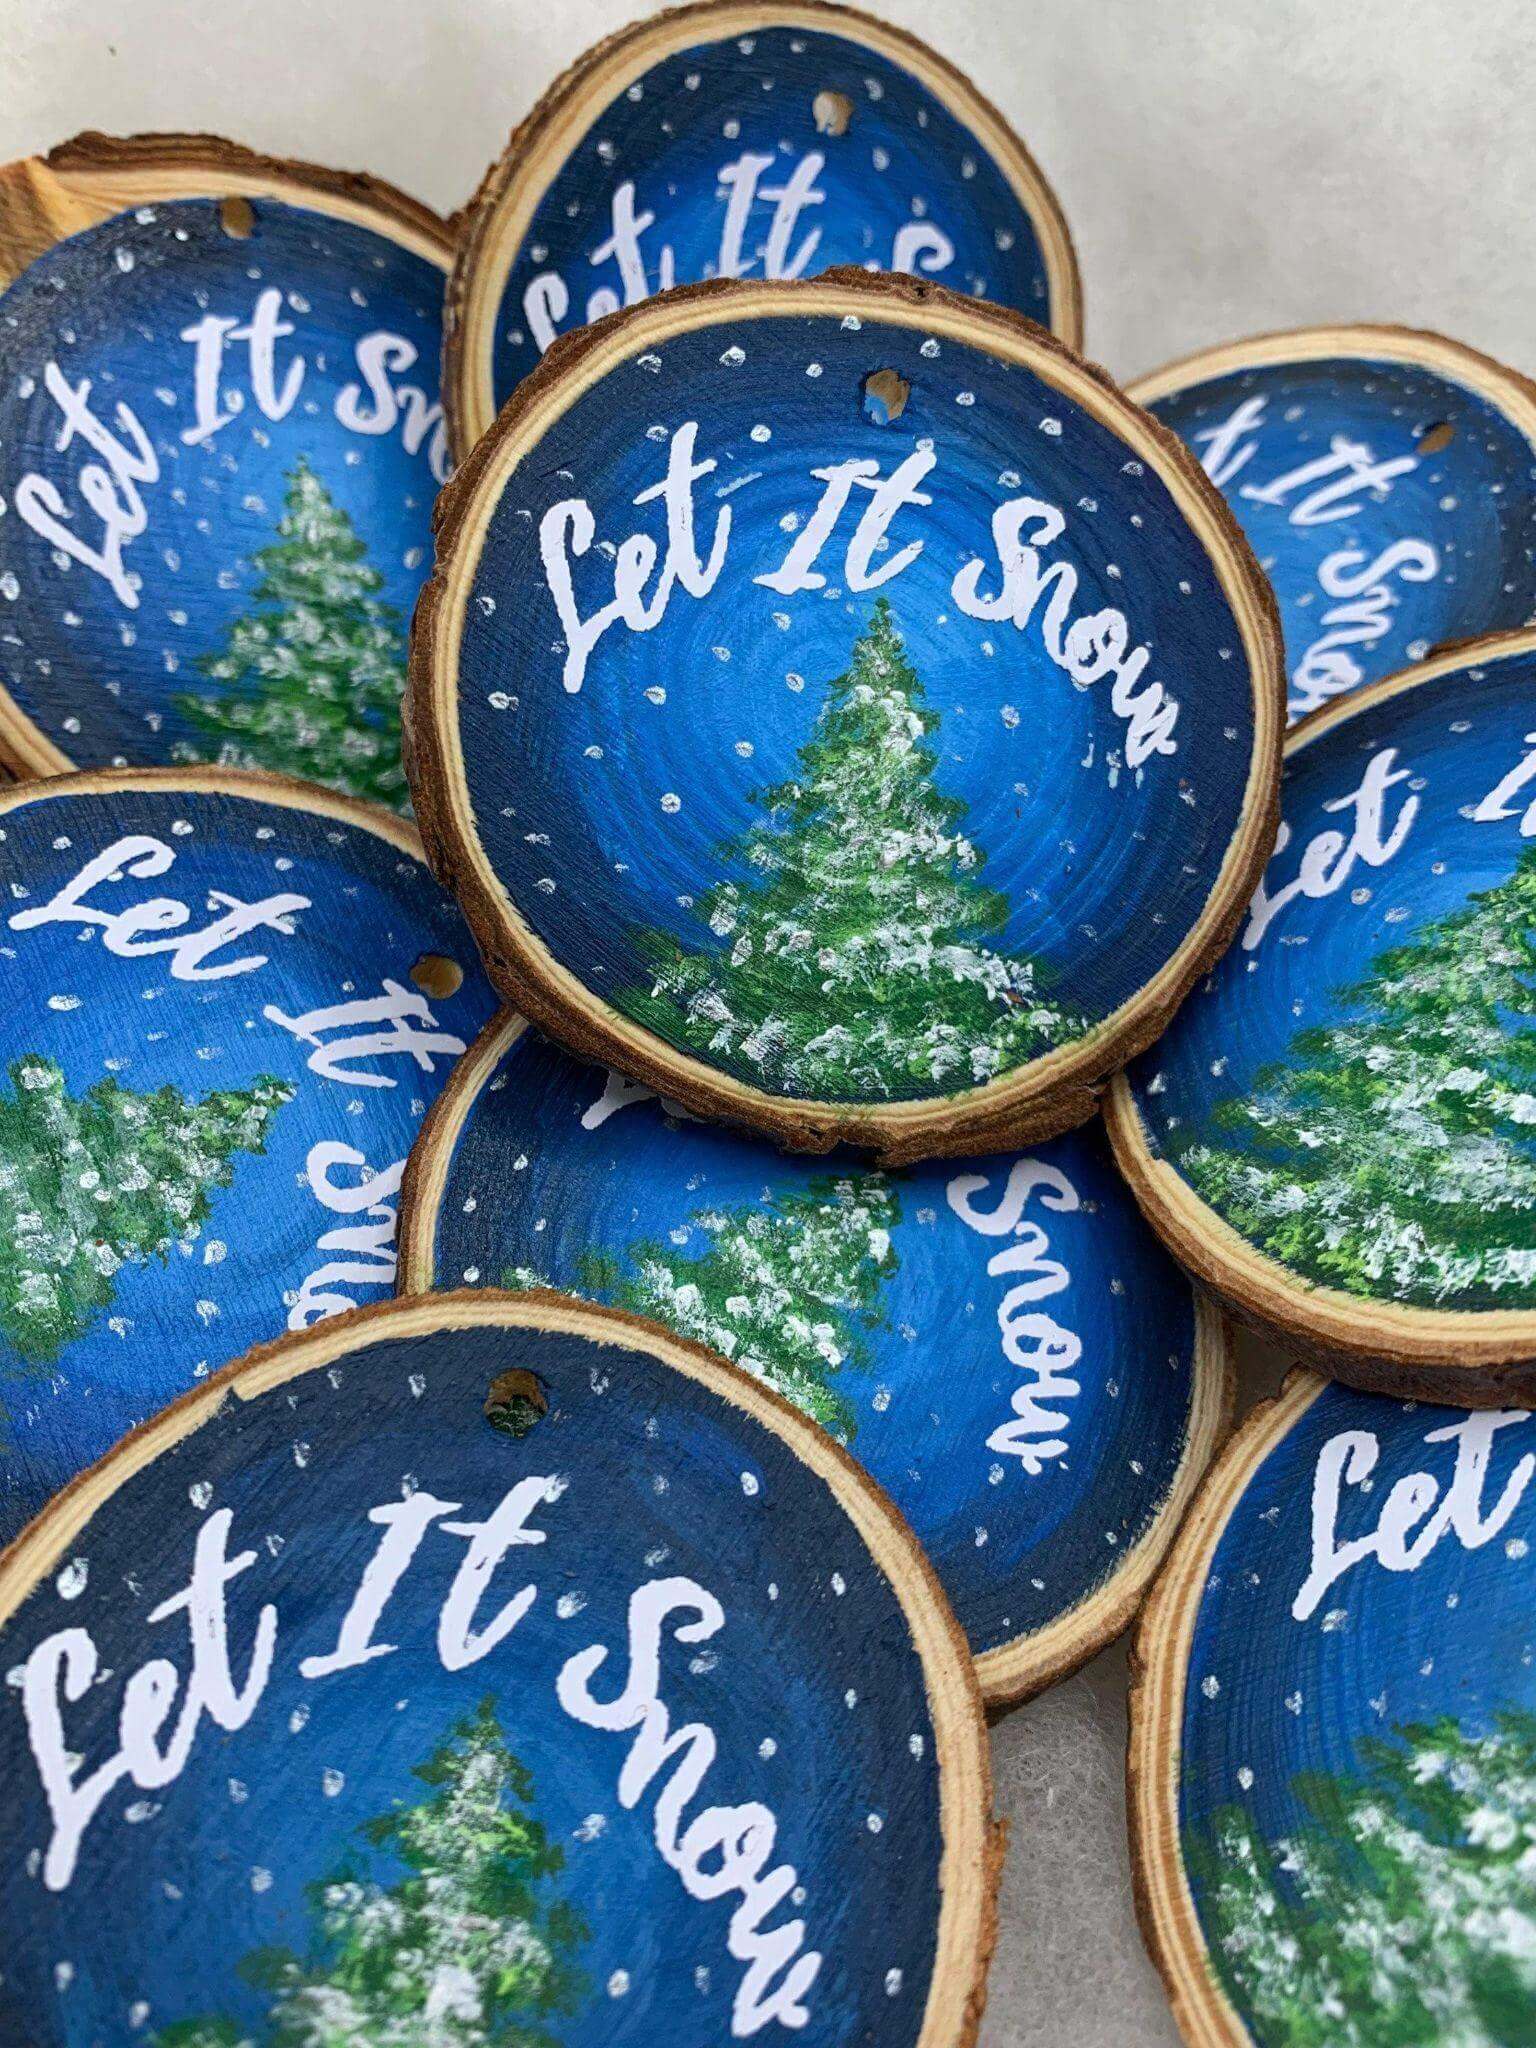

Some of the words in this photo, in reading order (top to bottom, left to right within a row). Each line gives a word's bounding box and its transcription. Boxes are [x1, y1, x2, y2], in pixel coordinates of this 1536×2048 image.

[718, 152, 826, 281] It
[15, 361, 160, 609] Let
[181, 288, 305, 445] It
[335, 331, 455, 484] Sn
[1239, 435, 1420, 526] It
[540, 422, 731, 693] Let
[753, 450, 937, 594] It
[951, 497, 1178, 768] Snow
[9, 836, 311, 981] Let
[264, 979, 467, 1087] It
[946, 1158, 1081, 1475] Snow
[1292, 1409, 1535, 1621] Let
[23, 1508, 277, 1891] Let
[300, 1476, 552, 1678] It
[557, 1577, 821, 2037] Snow
